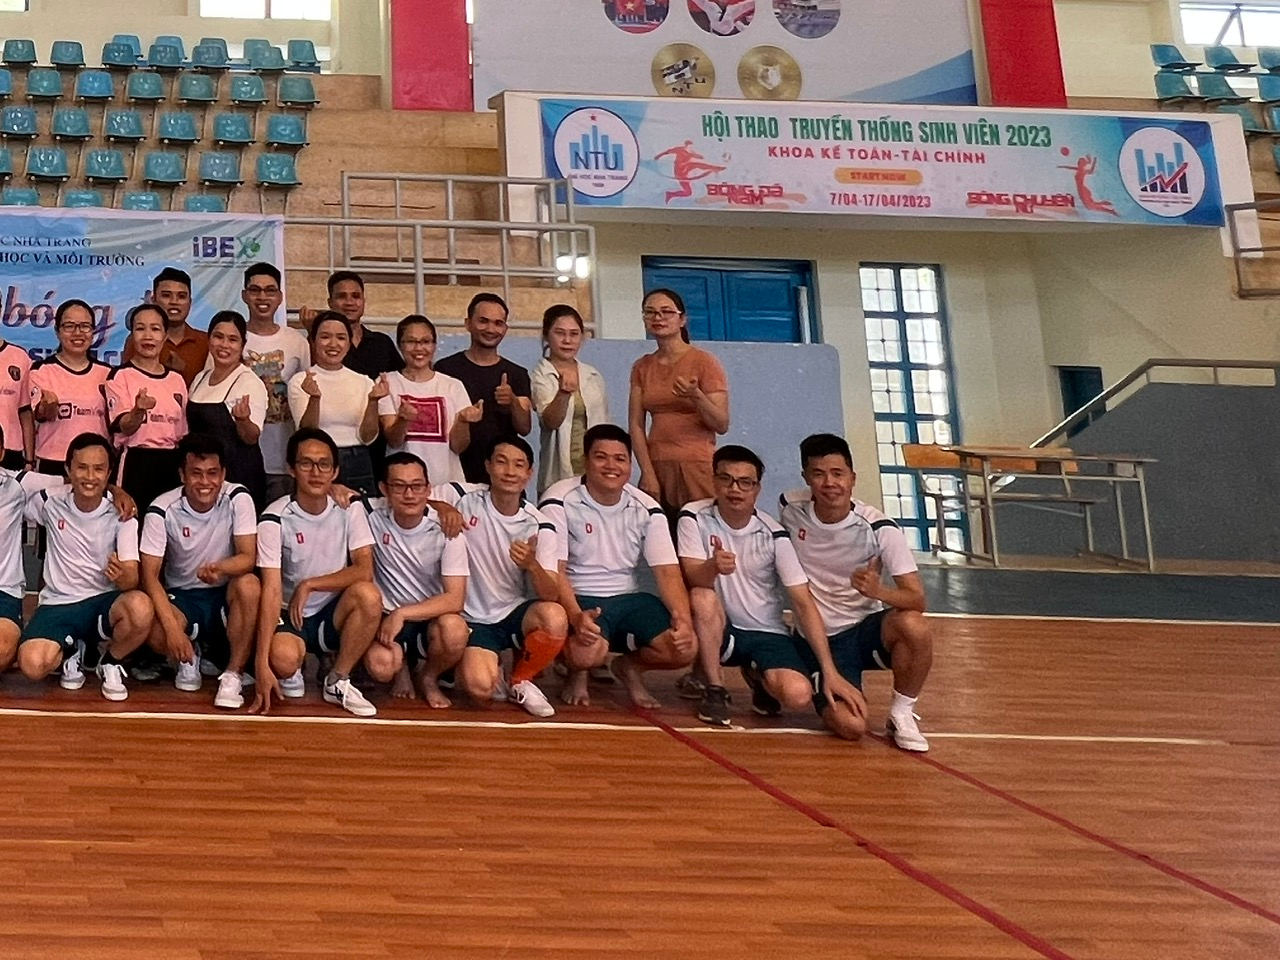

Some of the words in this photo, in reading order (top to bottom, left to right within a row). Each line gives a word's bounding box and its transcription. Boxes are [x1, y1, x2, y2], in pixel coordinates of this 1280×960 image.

[701, 110, 731, 143] HỘI
[918, 121, 958, 145] SINH
[962, 117, 1002, 146] VIÊN
[1007, 124, 1053, 147] 2023
[574, 151, 618, 170] NTU
[768, 145, 814, 159] KHOA
[820, 144, 841, 160] KẾ
[934, 148, 987, 165] CHÍNH
[829, 192, 932, 209] 7/04-17/04/2023
[12, 236, 42, 247] NHA
[45, 236, 92, 248] TRANG
[55, 251, 83, 266] MÔI
[86, 253, 145, 267] TRƯỜNG
